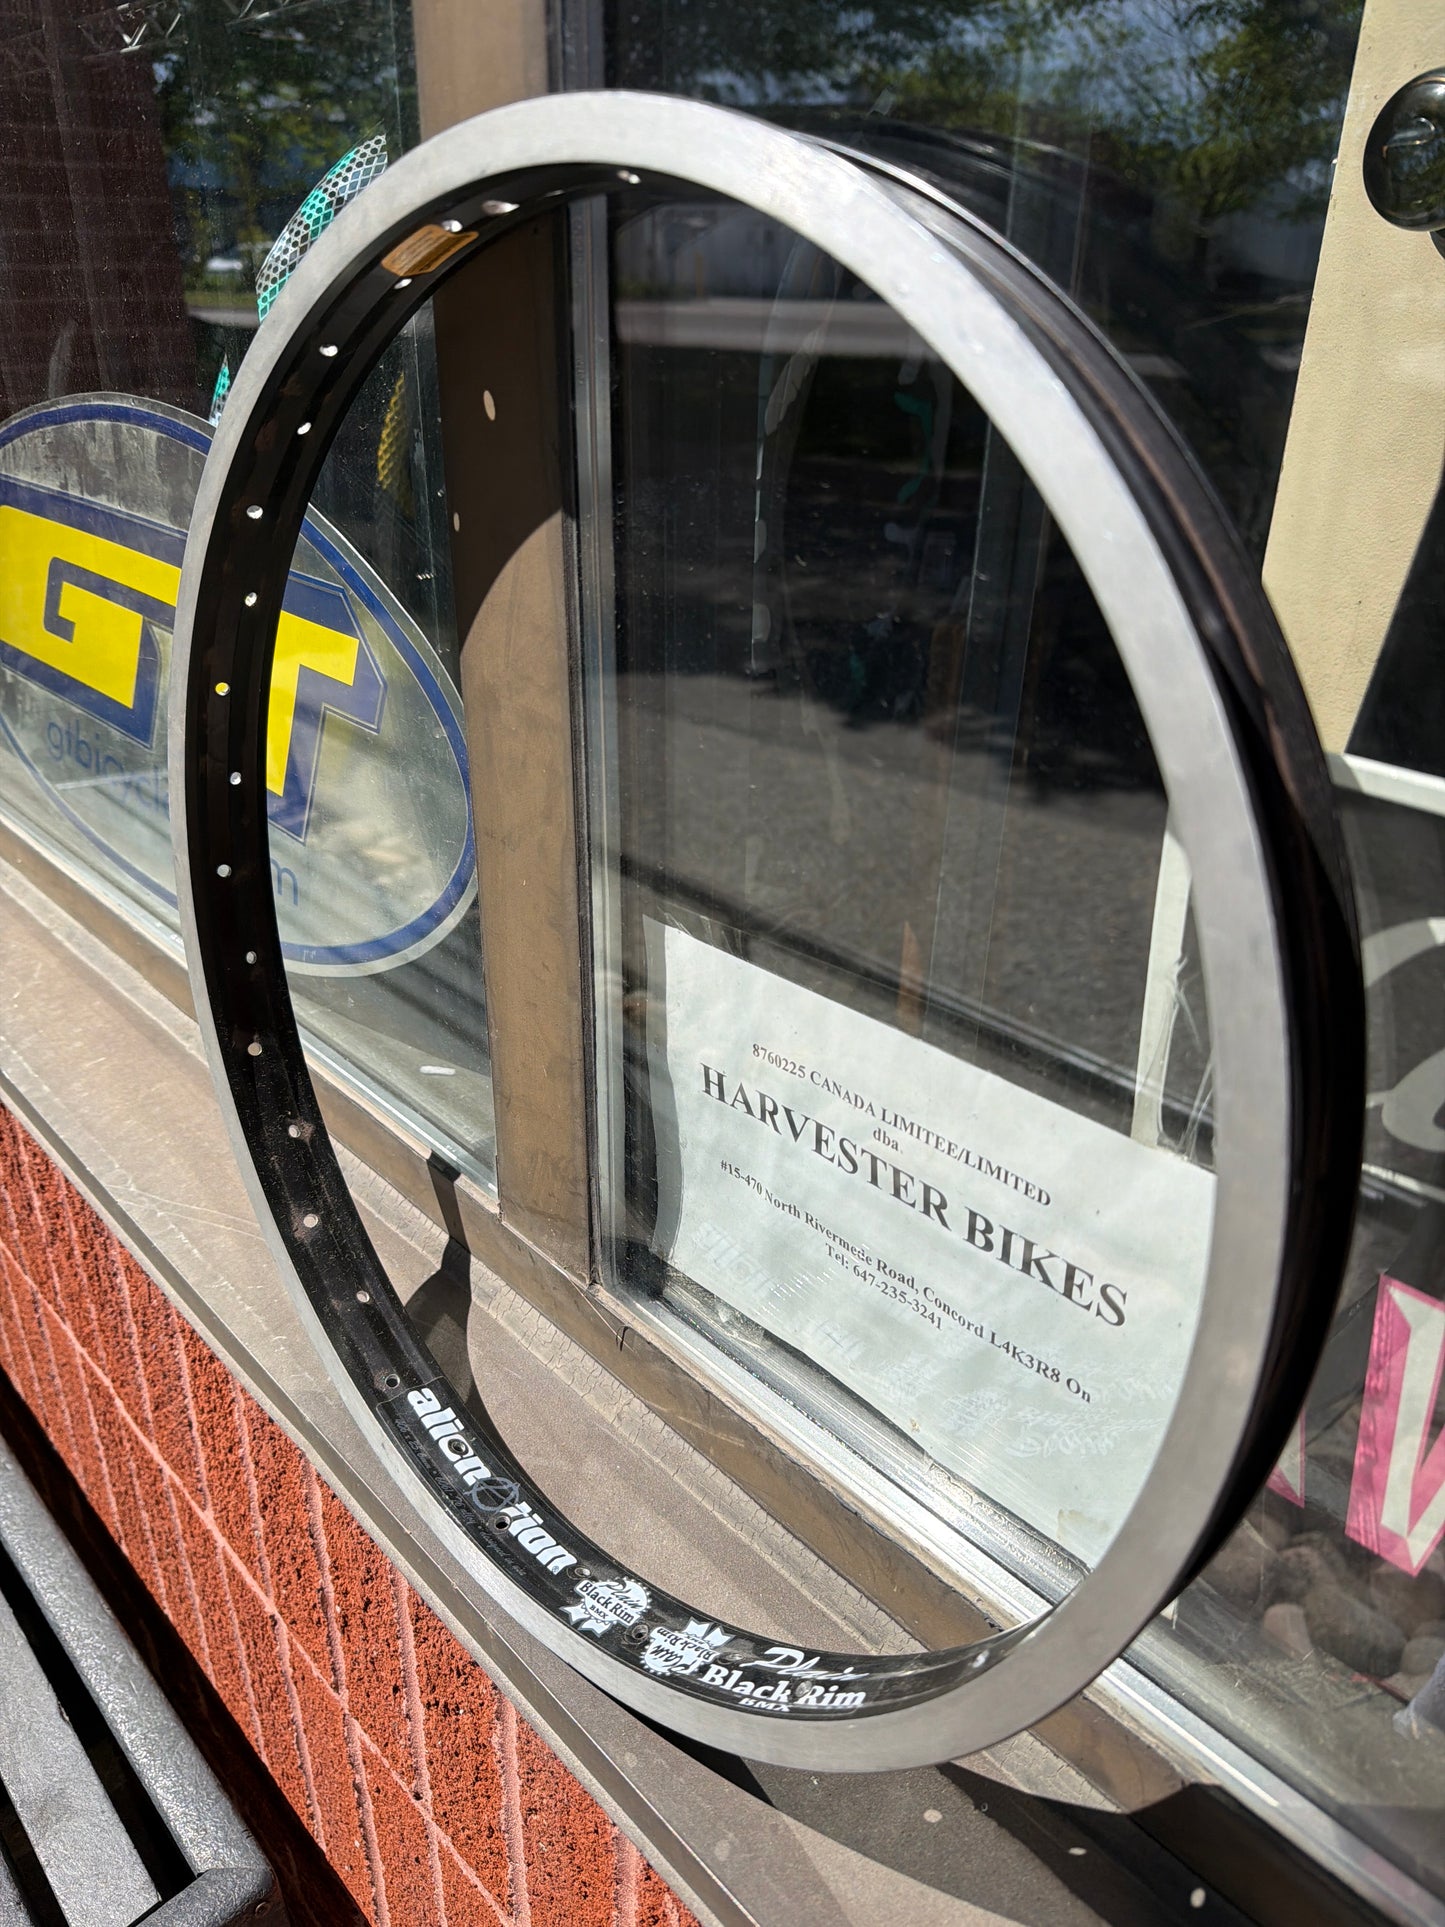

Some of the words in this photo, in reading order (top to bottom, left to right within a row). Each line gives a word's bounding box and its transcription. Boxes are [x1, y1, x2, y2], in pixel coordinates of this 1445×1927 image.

[0, 500, 362, 799] GT
[752, 1043, 806, 1079] 8760225
[810, 1070, 876, 1117] CANADA
[881, 1106, 1051, 1207] LIMITEE/LIMITED
[872, 1127, 900, 1152] dba
[700, 1062, 952, 1232] HARVESTER
[961, 1205, 1128, 1328] BIKES
[720, 1159, 763, 1196] #15-470
[764, 1191, 801, 1220] North
[804, 1210, 873, 1266] Rivermede
[876, 1256, 919, 1294] Road,
[923, 1286, 984, 1338] Concord
[989, 1330, 1061, 1383] L4K3R8
[1065, 1378, 1092, 1404] On
[825, 1242, 850, 1270] Tel:
[852, 1264, 943, 1331] 647-235-3241
[579, 1581, 611, 1610] Black
[608, 1602, 635, 1624] Rim
[589, 1604, 610, 1620] BMX
[598, 1578, 644, 1610] Plain
[656, 1627, 681, 1647] Rim
[697, 1663, 792, 1704] Black
[793, 1680, 867, 1708] Rim
[738, 1697, 793, 1713] BMX
